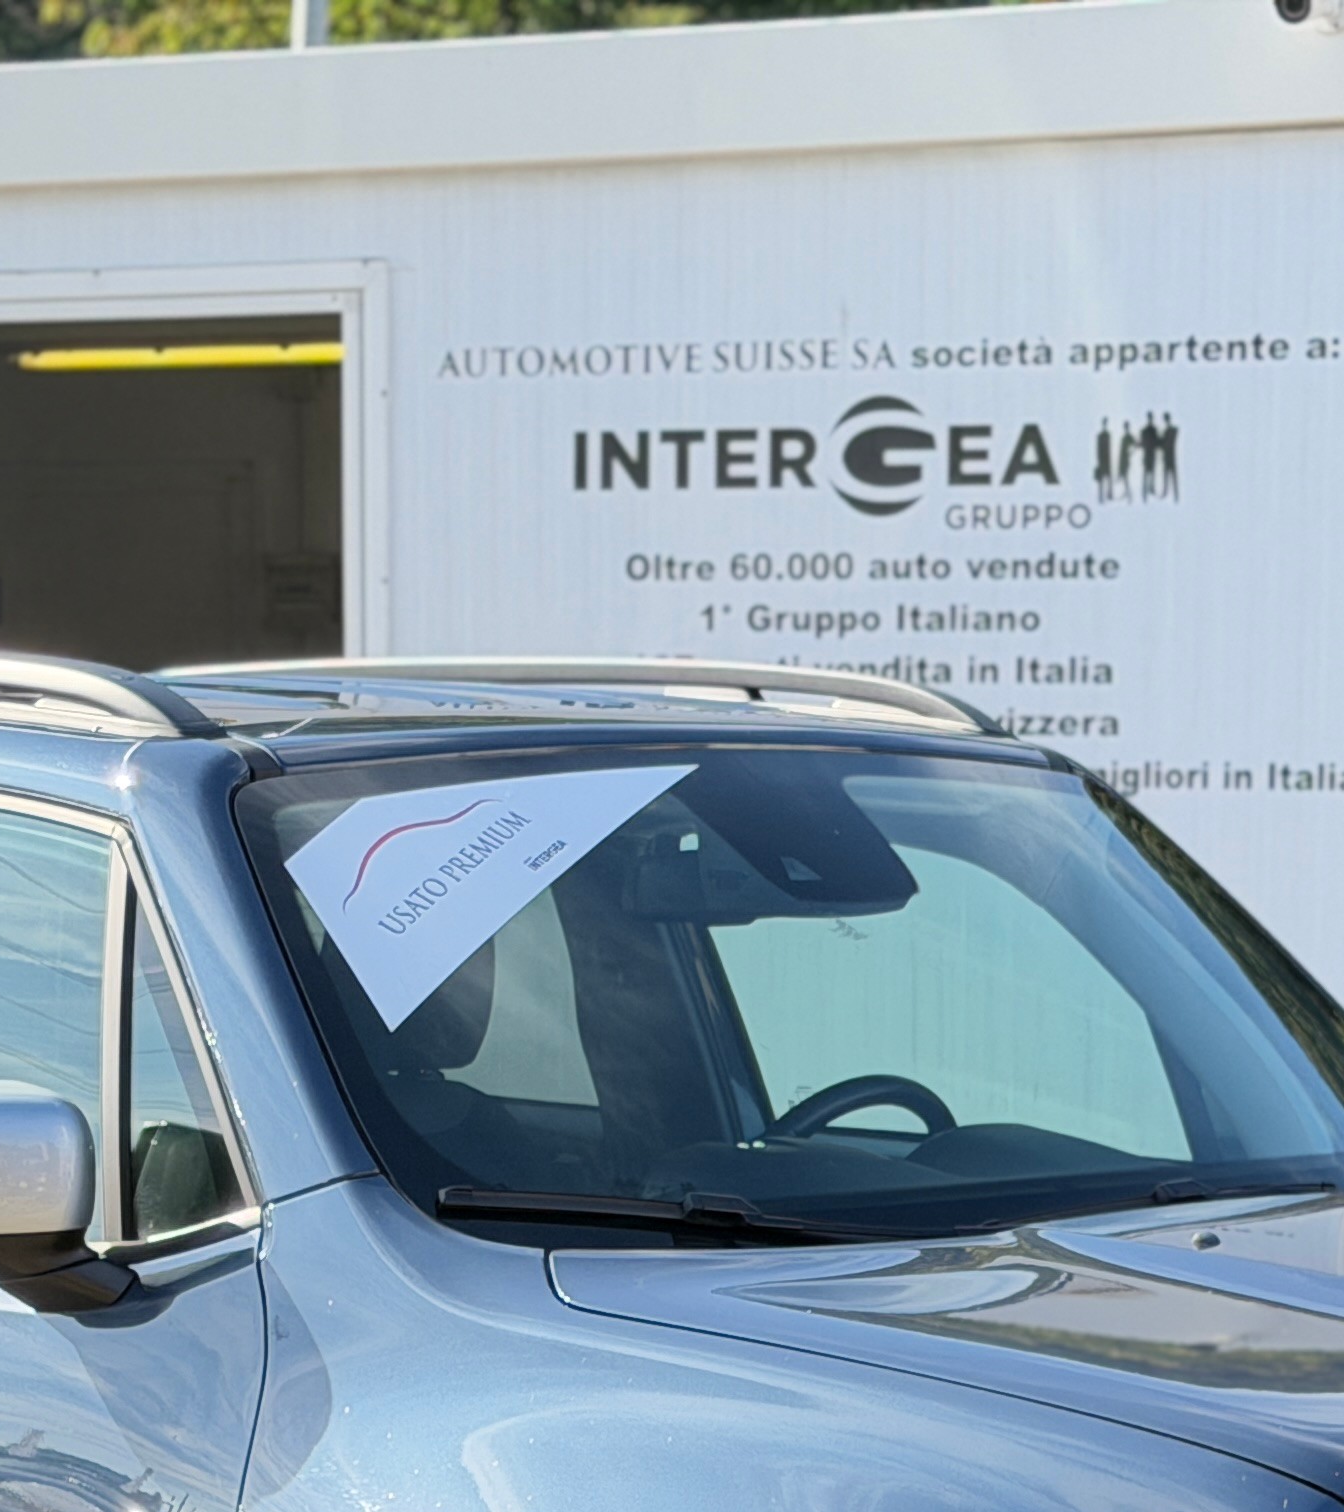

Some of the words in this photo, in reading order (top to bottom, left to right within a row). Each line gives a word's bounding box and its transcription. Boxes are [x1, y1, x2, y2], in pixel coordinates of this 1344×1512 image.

[438, 343, 702, 379] AUTOMOTIVE
[713, 339, 839, 373] SUISSE
[852, 339, 896, 370] SA
[911, 336, 1053, 367] società
[1069, 333, 1290, 371] appartente
[1306, 335, 1341, 360] a:
[945, 504, 1091, 530] GRUPPO
[626, 553, 715, 582] Oltre
[730, 553, 853, 581] 60.000
[868, 556, 952, 580] auto
[968, 552, 1120, 580] vendute
[747, 603, 881, 639] Gruppo
[897, 603, 1041, 633] Italiano
[967, 656, 999, 684] in
[1016, 656, 1114, 685] Italia
[996, 709, 1120, 736] izzera
[1223, 761, 1253, 789] in
[378, 877, 449, 935] USATO
[438, 810, 532, 883] PREMIUM
